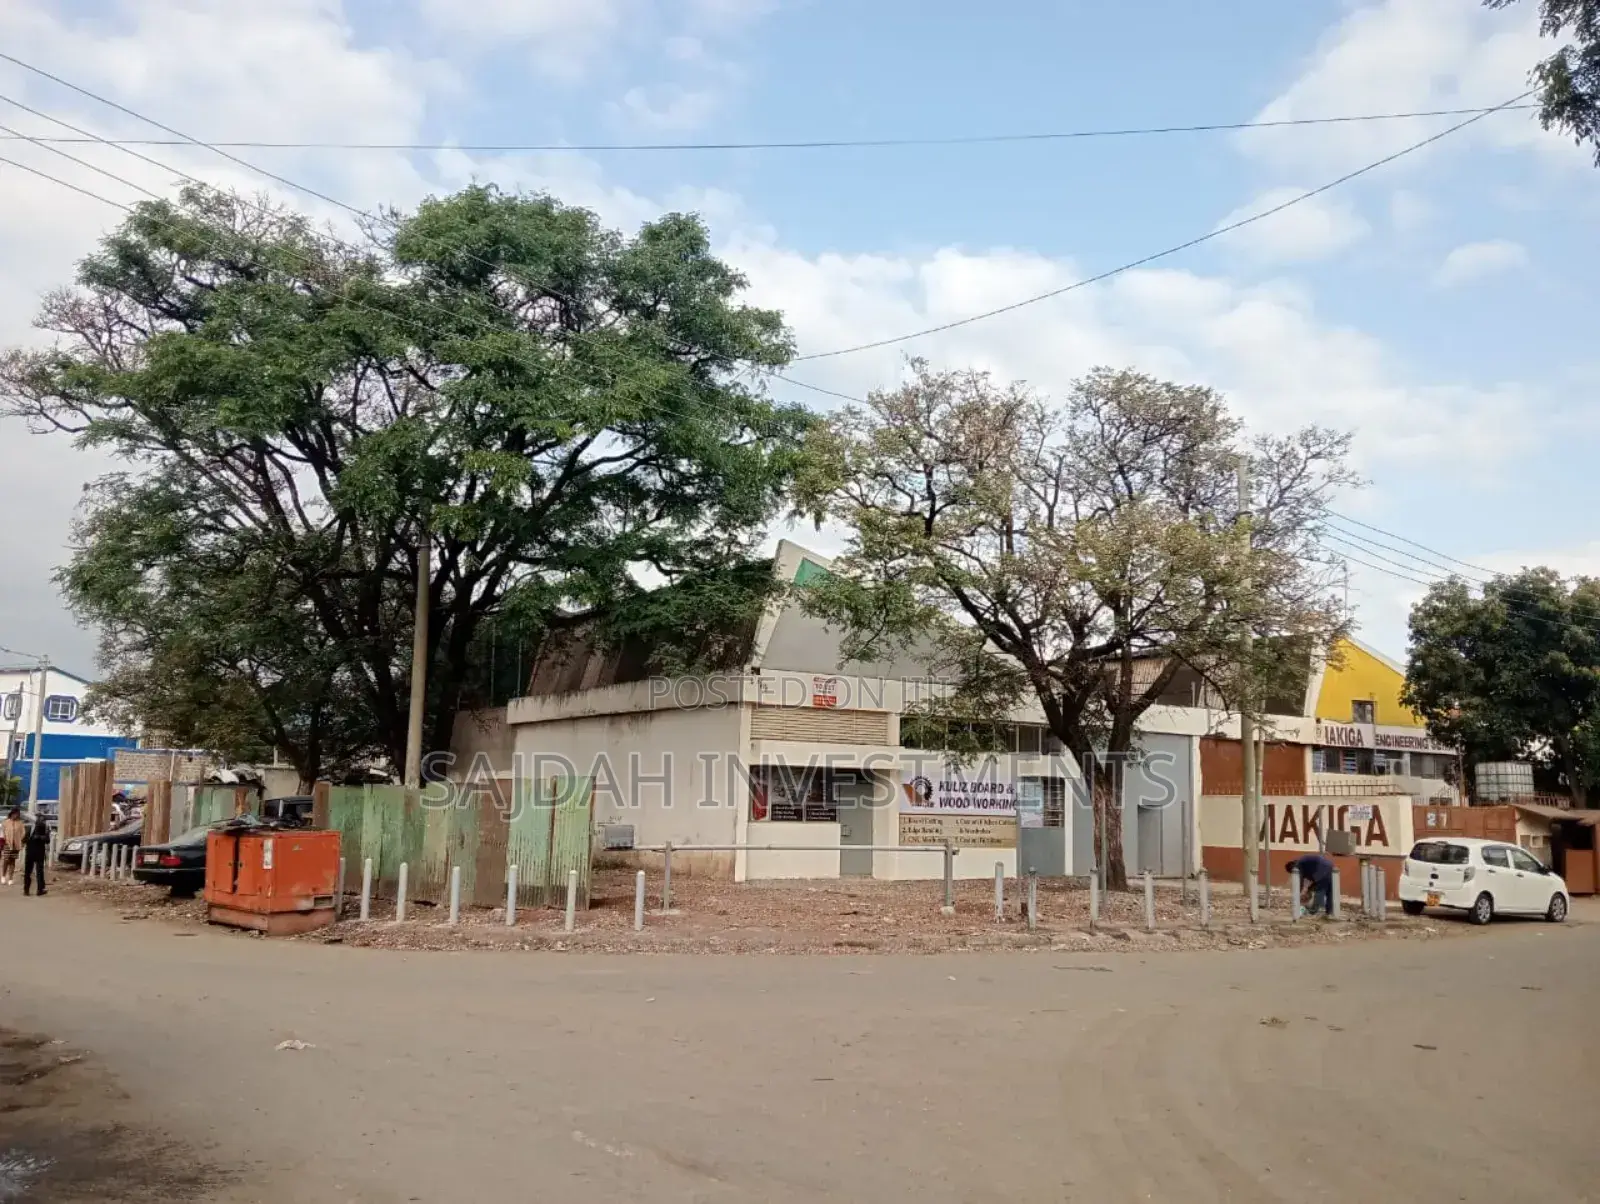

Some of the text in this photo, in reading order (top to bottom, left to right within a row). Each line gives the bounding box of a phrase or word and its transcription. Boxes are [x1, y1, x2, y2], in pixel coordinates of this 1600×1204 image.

[970, 782, 1004, 794] BOARD
[1006, 783, 1015, 795] &
[939, 797, 970, 809] WOOD
